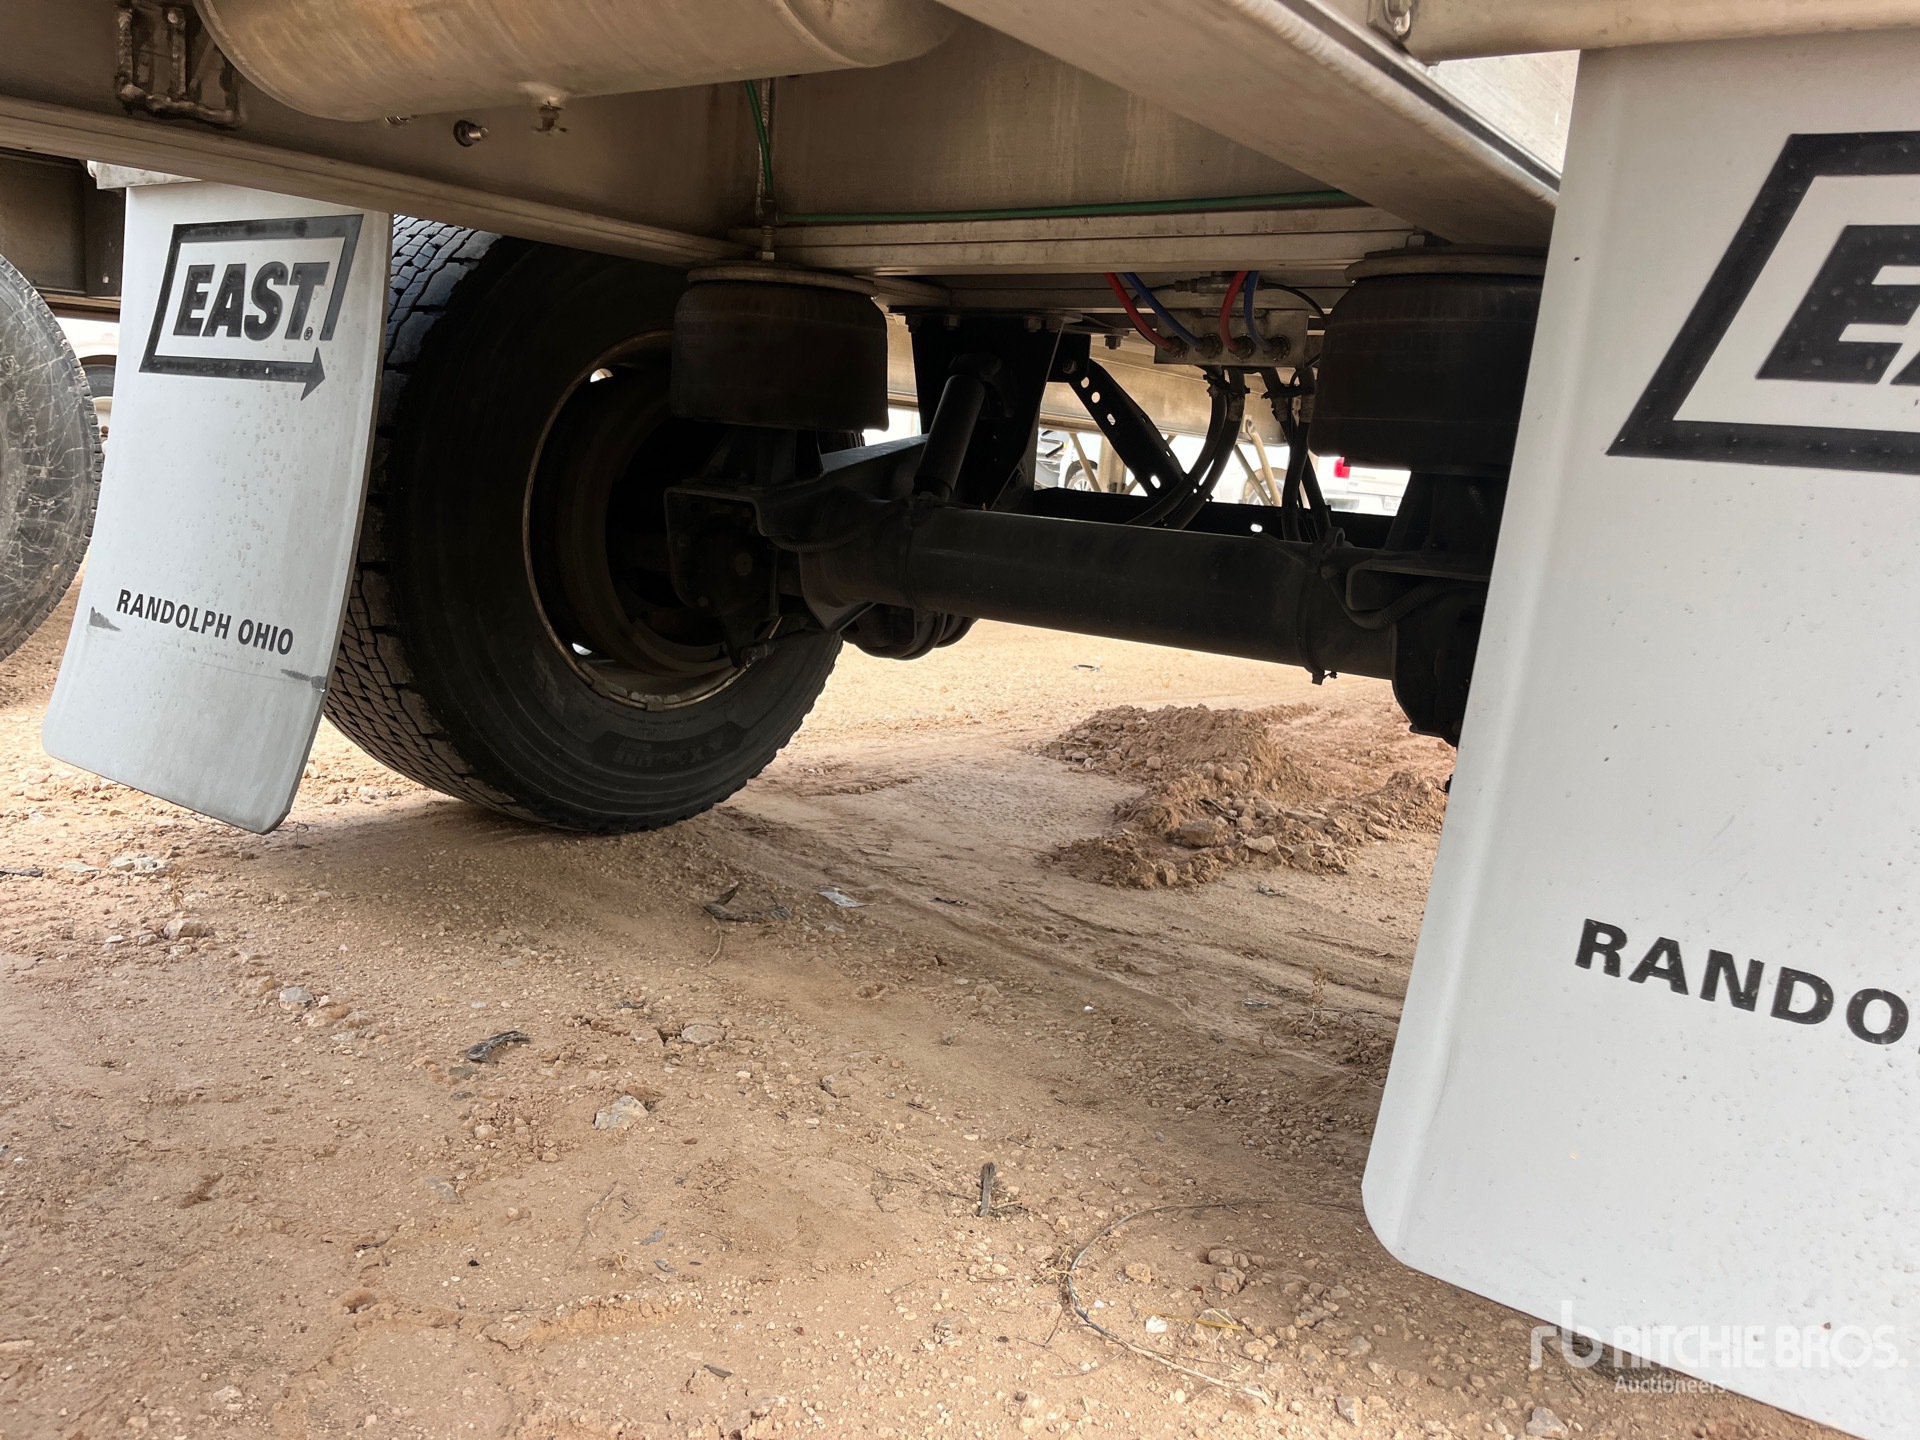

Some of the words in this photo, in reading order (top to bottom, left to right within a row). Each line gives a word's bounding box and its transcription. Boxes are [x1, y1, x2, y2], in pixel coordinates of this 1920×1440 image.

[116, 589, 232, 640] RANDOLPH
[238, 619, 294, 656] OHIO
[1575, 918, 1920, 1055] RANDO
